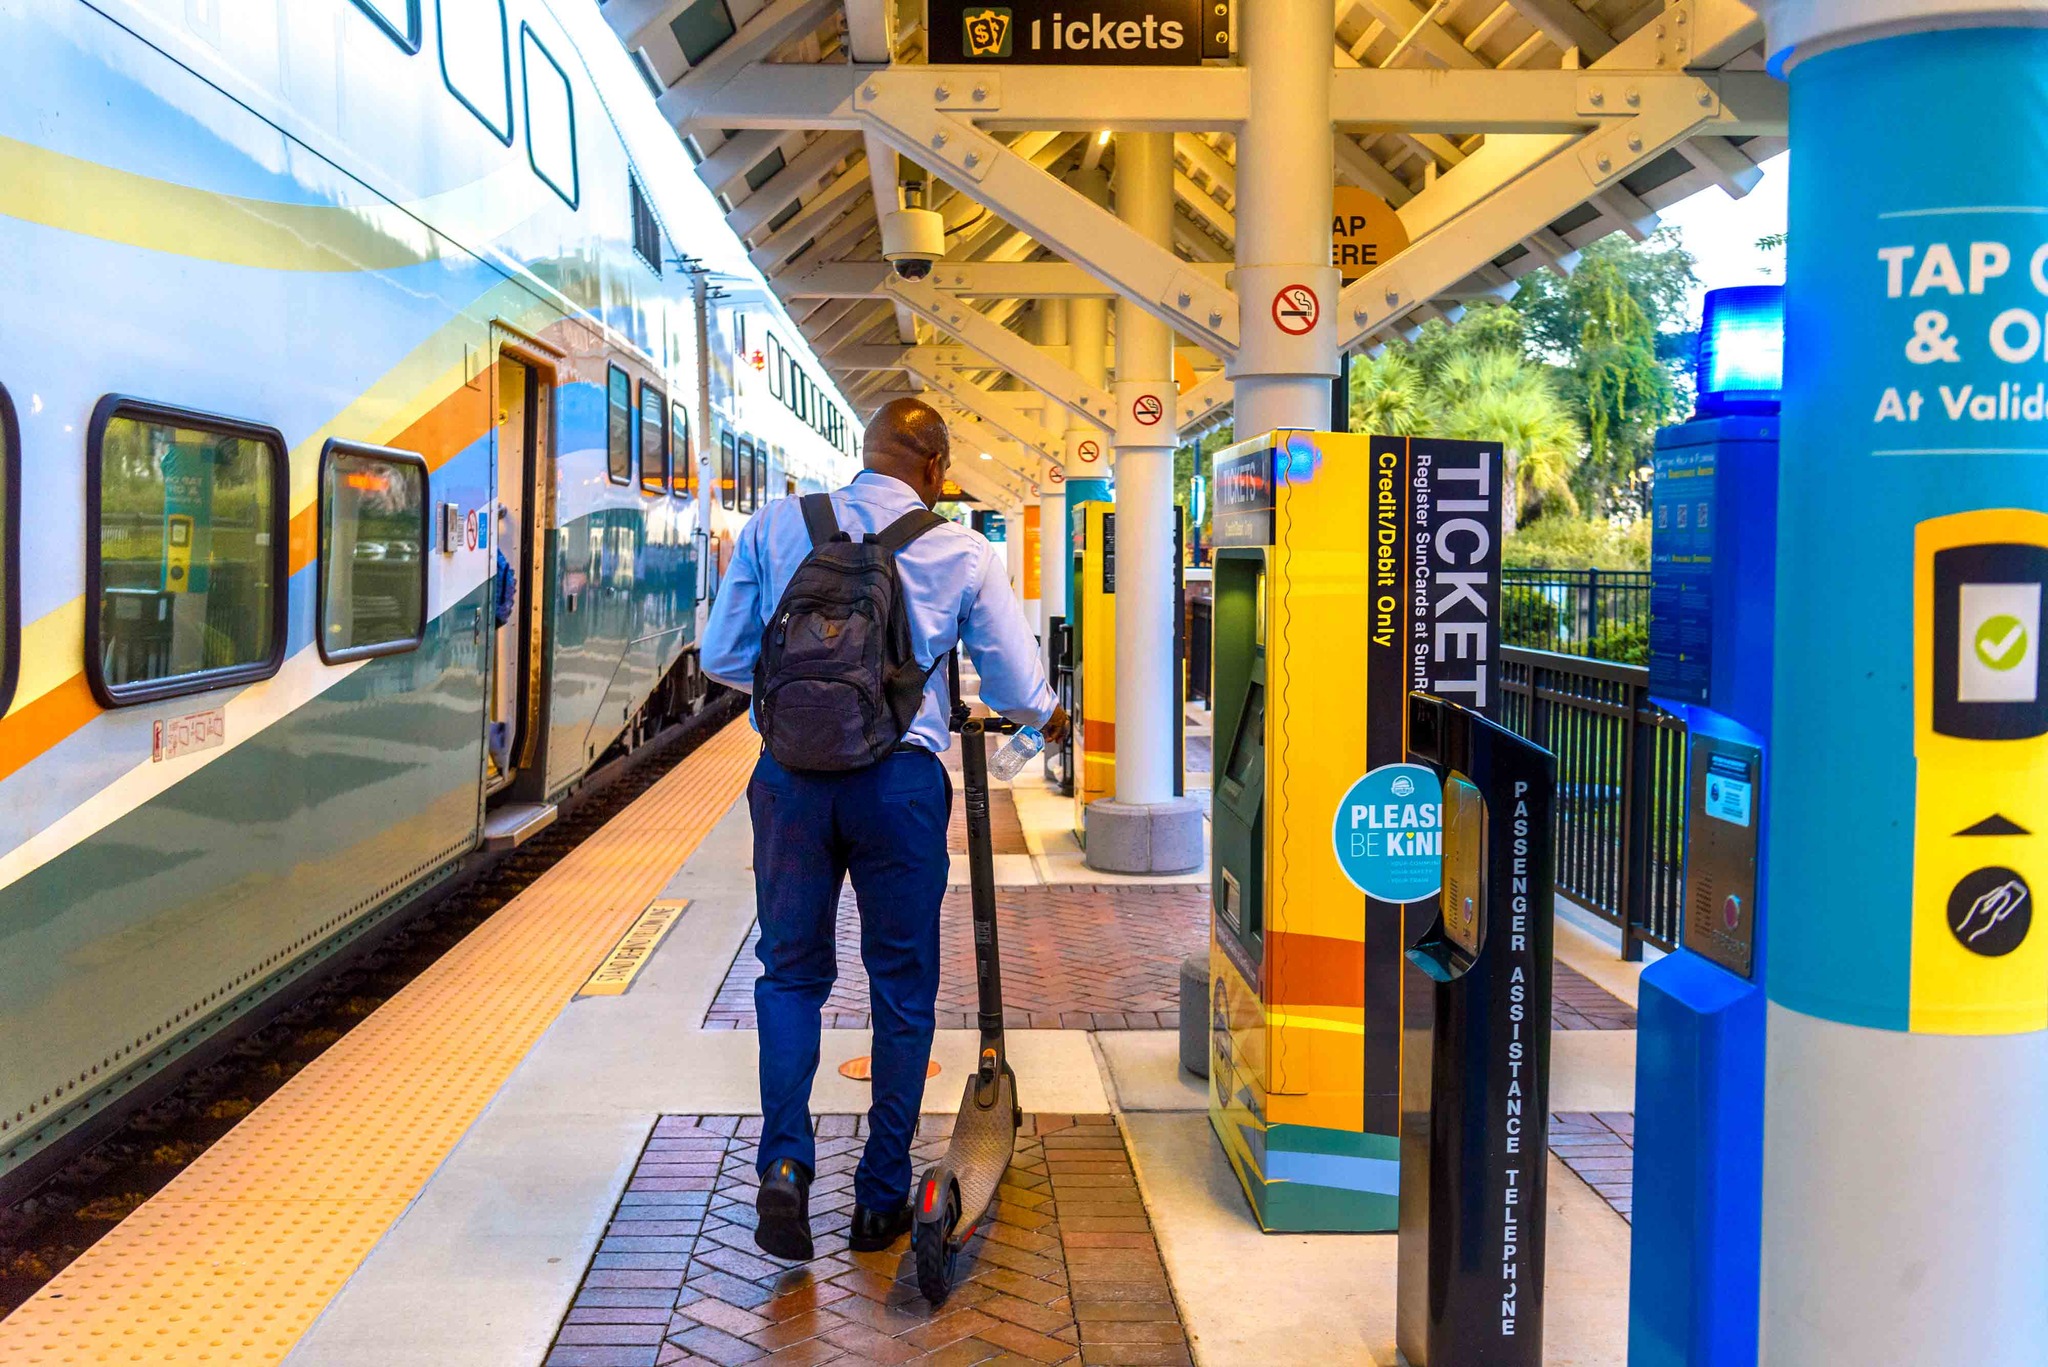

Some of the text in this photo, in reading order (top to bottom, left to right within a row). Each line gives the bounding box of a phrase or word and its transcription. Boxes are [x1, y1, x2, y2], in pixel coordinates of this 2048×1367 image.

[1333, 215, 1367, 238] AP
[1877, 241, 2011, 298] TAP
[1904, 307, 2048, 366] & O
[1873, 381, 2048, 423] At Valid
[1224, 462, 1256, 504] TICKETS
[1413, 454, 1432, 527] Register
[1373, 451, 1398, 648] Credit/Debit Only
[1414, 531, 1432, 618] SunCards
[1433, 452, 1491, 713] TICKET
[1414, 621, 1429, 639] at
[1350, 832, 1380, 858] BE
[1510, 780, 1529, 952] PASSENGER
[1506, 966, 1525, 1155] ASSISTANCE
